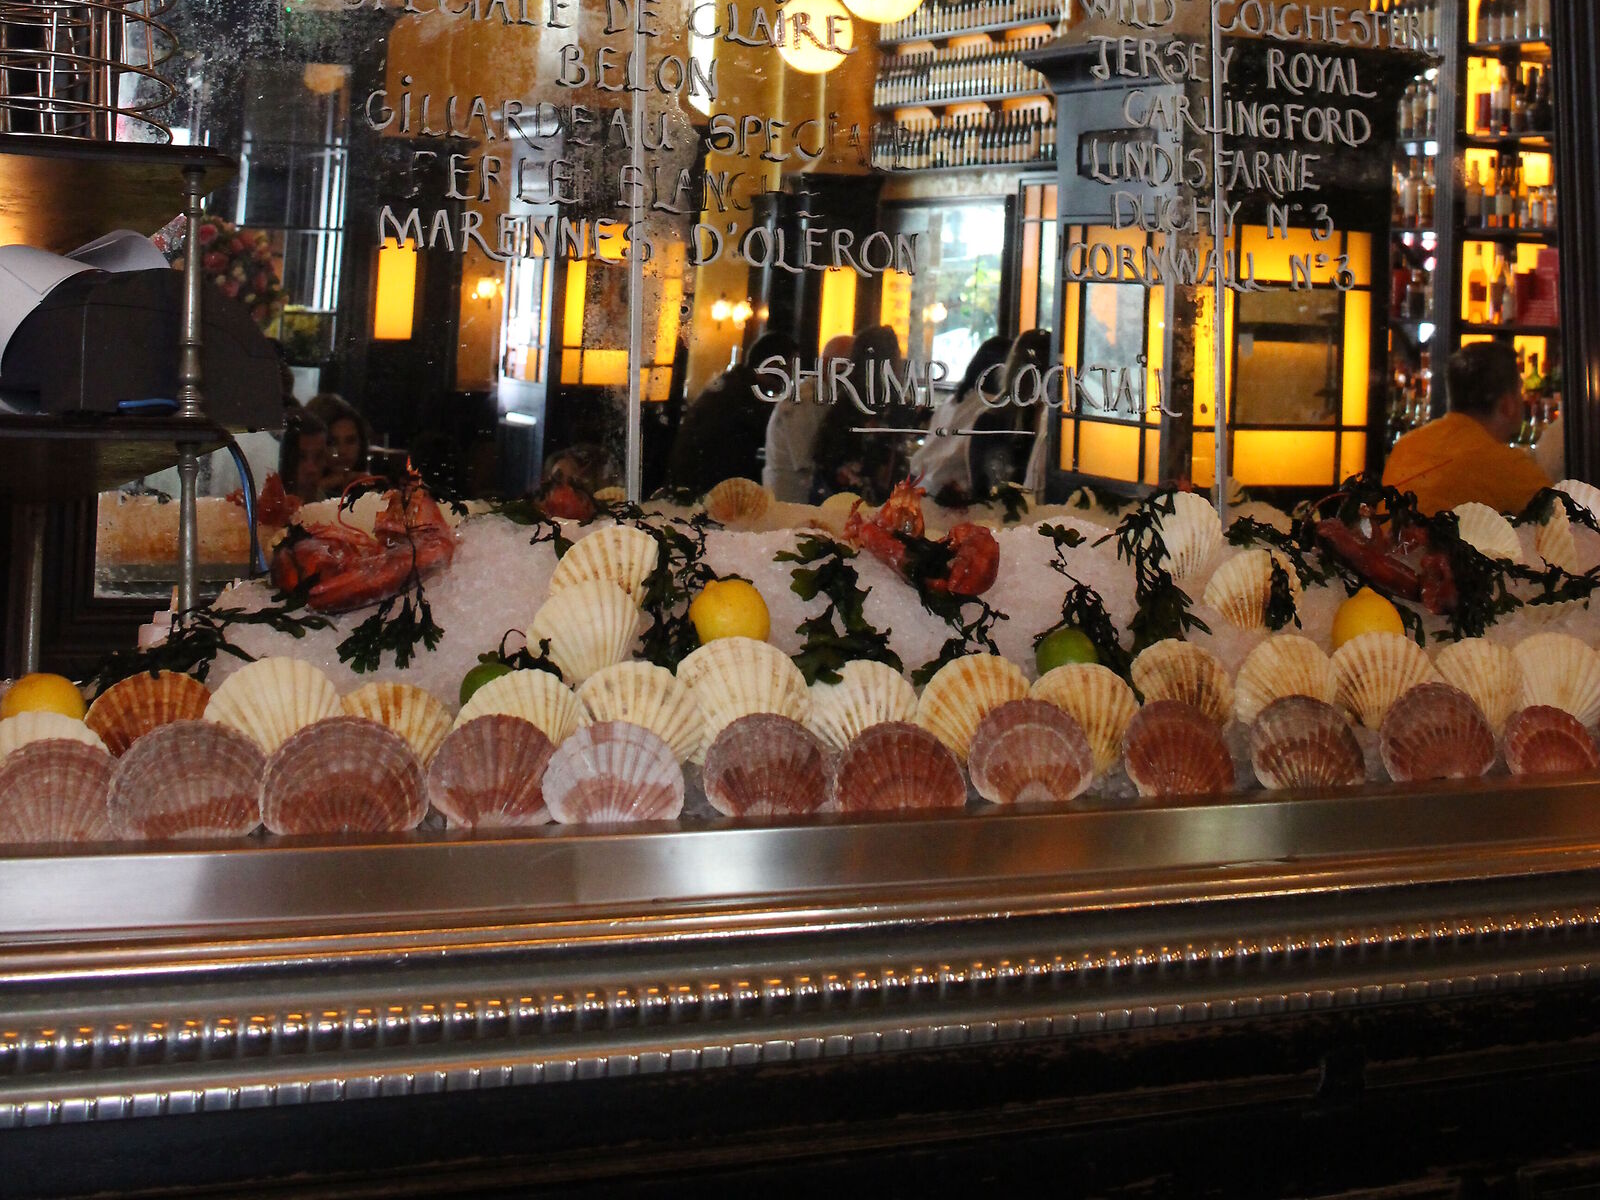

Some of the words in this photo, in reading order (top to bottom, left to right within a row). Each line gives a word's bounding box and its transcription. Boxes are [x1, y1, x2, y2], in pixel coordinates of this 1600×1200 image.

[556, 43, 720, 101] BELON
[1088, 34, 1235, 86] JERSEY
[1266, 48, 1378, 99] ROYAL
[1123, 89, 1372, 149] CARLINGFORD
[1088, 137, 1321, 199] LINDISFARNE
[378, 204, 655, 266] MARENNES
[1110, 190, 1243, 238] DUCHY
[1064, 241, 1280, 294] CORNWALL
[751, 345, 950, 417] SHRIMP
[976, 353, 1184, 419] COCKTAIL
